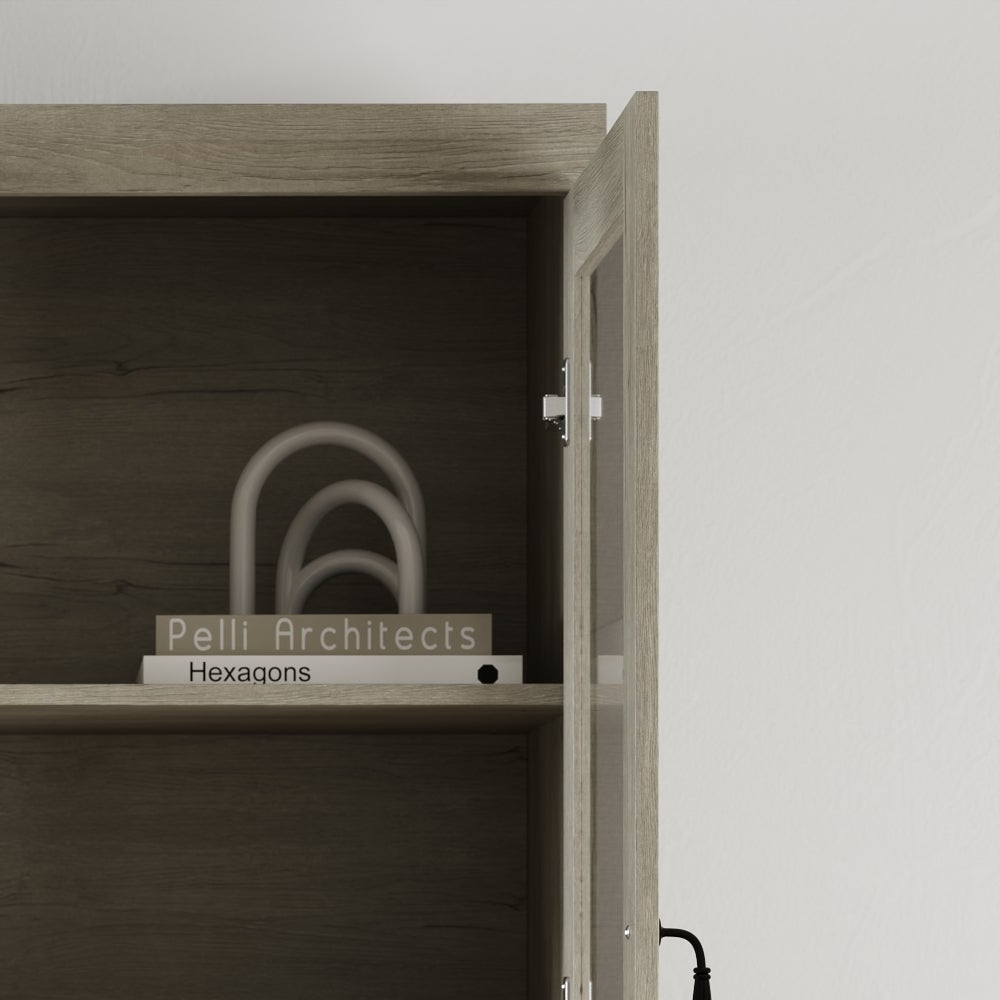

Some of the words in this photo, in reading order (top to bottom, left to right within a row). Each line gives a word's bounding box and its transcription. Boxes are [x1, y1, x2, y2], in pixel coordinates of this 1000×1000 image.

[168, 618, 248, 651] Pelli
[275, 618, 476, 651] Architects
[189, 661, 311, 685] Hexagons
